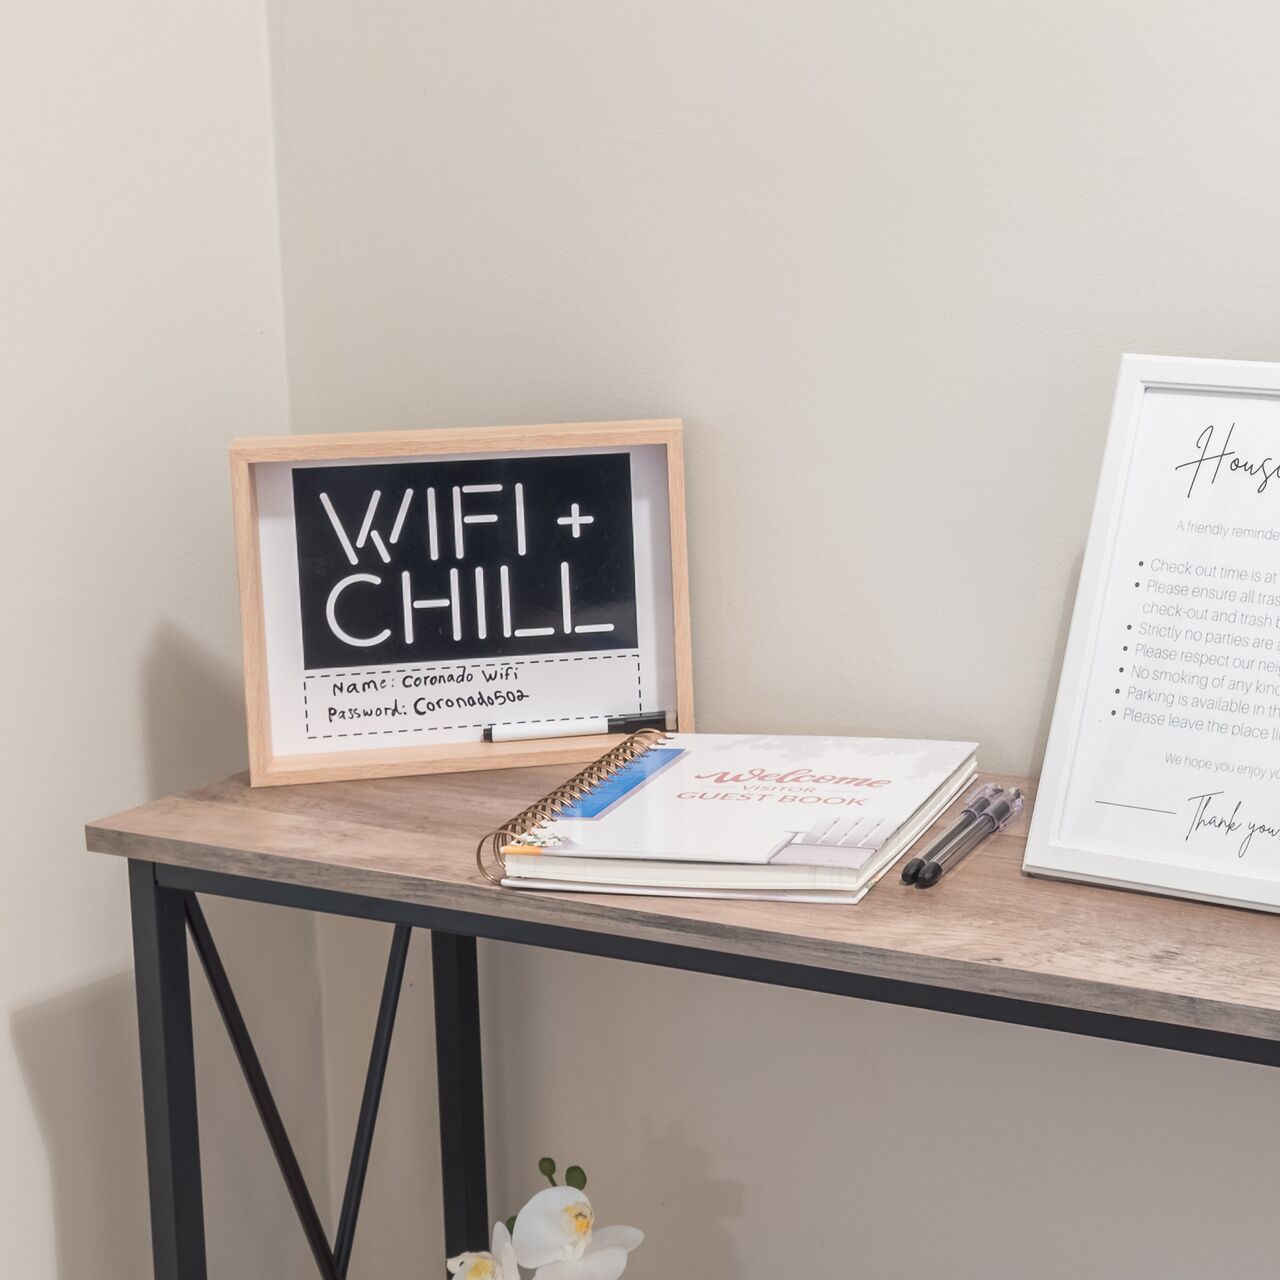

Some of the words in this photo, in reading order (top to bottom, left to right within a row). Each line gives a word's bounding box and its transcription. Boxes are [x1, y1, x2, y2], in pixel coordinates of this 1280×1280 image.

[319, 482, 526, 565] WIFI
[557, 503, 594, 538] +
[1176, 520, 1185, 532] A
[1187, 521, 1229, 538] friendly
[1150, 558, 1193, 575] Check
[1195, 564, 1217, 577] out
[1220, 566, 1248, 580] time
[1251, 569, 1261, 581] is
[1264, 572, 1277, 584] at
[326, 562, 615, 647] CHILL
[1147, 579, 1189, 596] Please
[1192, 586, 1237, 601] ensure
[1240, 590, 1255, 603] all
[1142, 602, 1209, 620] check-out
[1211, 610, 1237, 624] and
[1240, 612, 1272, 627] trash
[1139, 622, 1182, 641] Strictly
[1185, 629, 1203, 641] no
[1205, 631, 1249, 647] parties
[1252, 637, 1274, 650] are
[1135, 643, 1177, 660] Please
[1180, 650, 1229, 667] respect
[1232, 657, 1256, 670] our
[332, 678, 396, 696] Name:
[402, 666, 474, 689] Coronado
[482, 666, 518, 683] Wifi
[1131, 664, 1150, 679] No
[1152, 669, 1208, 690] smoking
[1211, 674, 1226, 688] of
[1228, 679, 1253, 695] any
[413, 689, 530, 716] Coronado502
[1127, 685, 1175, 708] Parking
[1178, 694, 1189, 706] is
[1191, 696, 1250, 714] available
[1253, 703, 1264, 716] in
[1123, 707, 1165, 725] Please
[1168, 713, 1204, 731] leave
[1207, 718, 1228, 734] the
[1231, 721, 1269, 740] place
[1165, 752, 1182, 765] We
[1184, 754, 1212, 770] hope
[1215, 761, 1235, 774] you
[1237, 763, 1267, 778] enjoy
[676, 791, 773, 803] GUEST
[777, 795, 868, 807] BOOK
[743, 784, 816, 793] VISITOR
[1185, 791, 1242, 842] Thank
